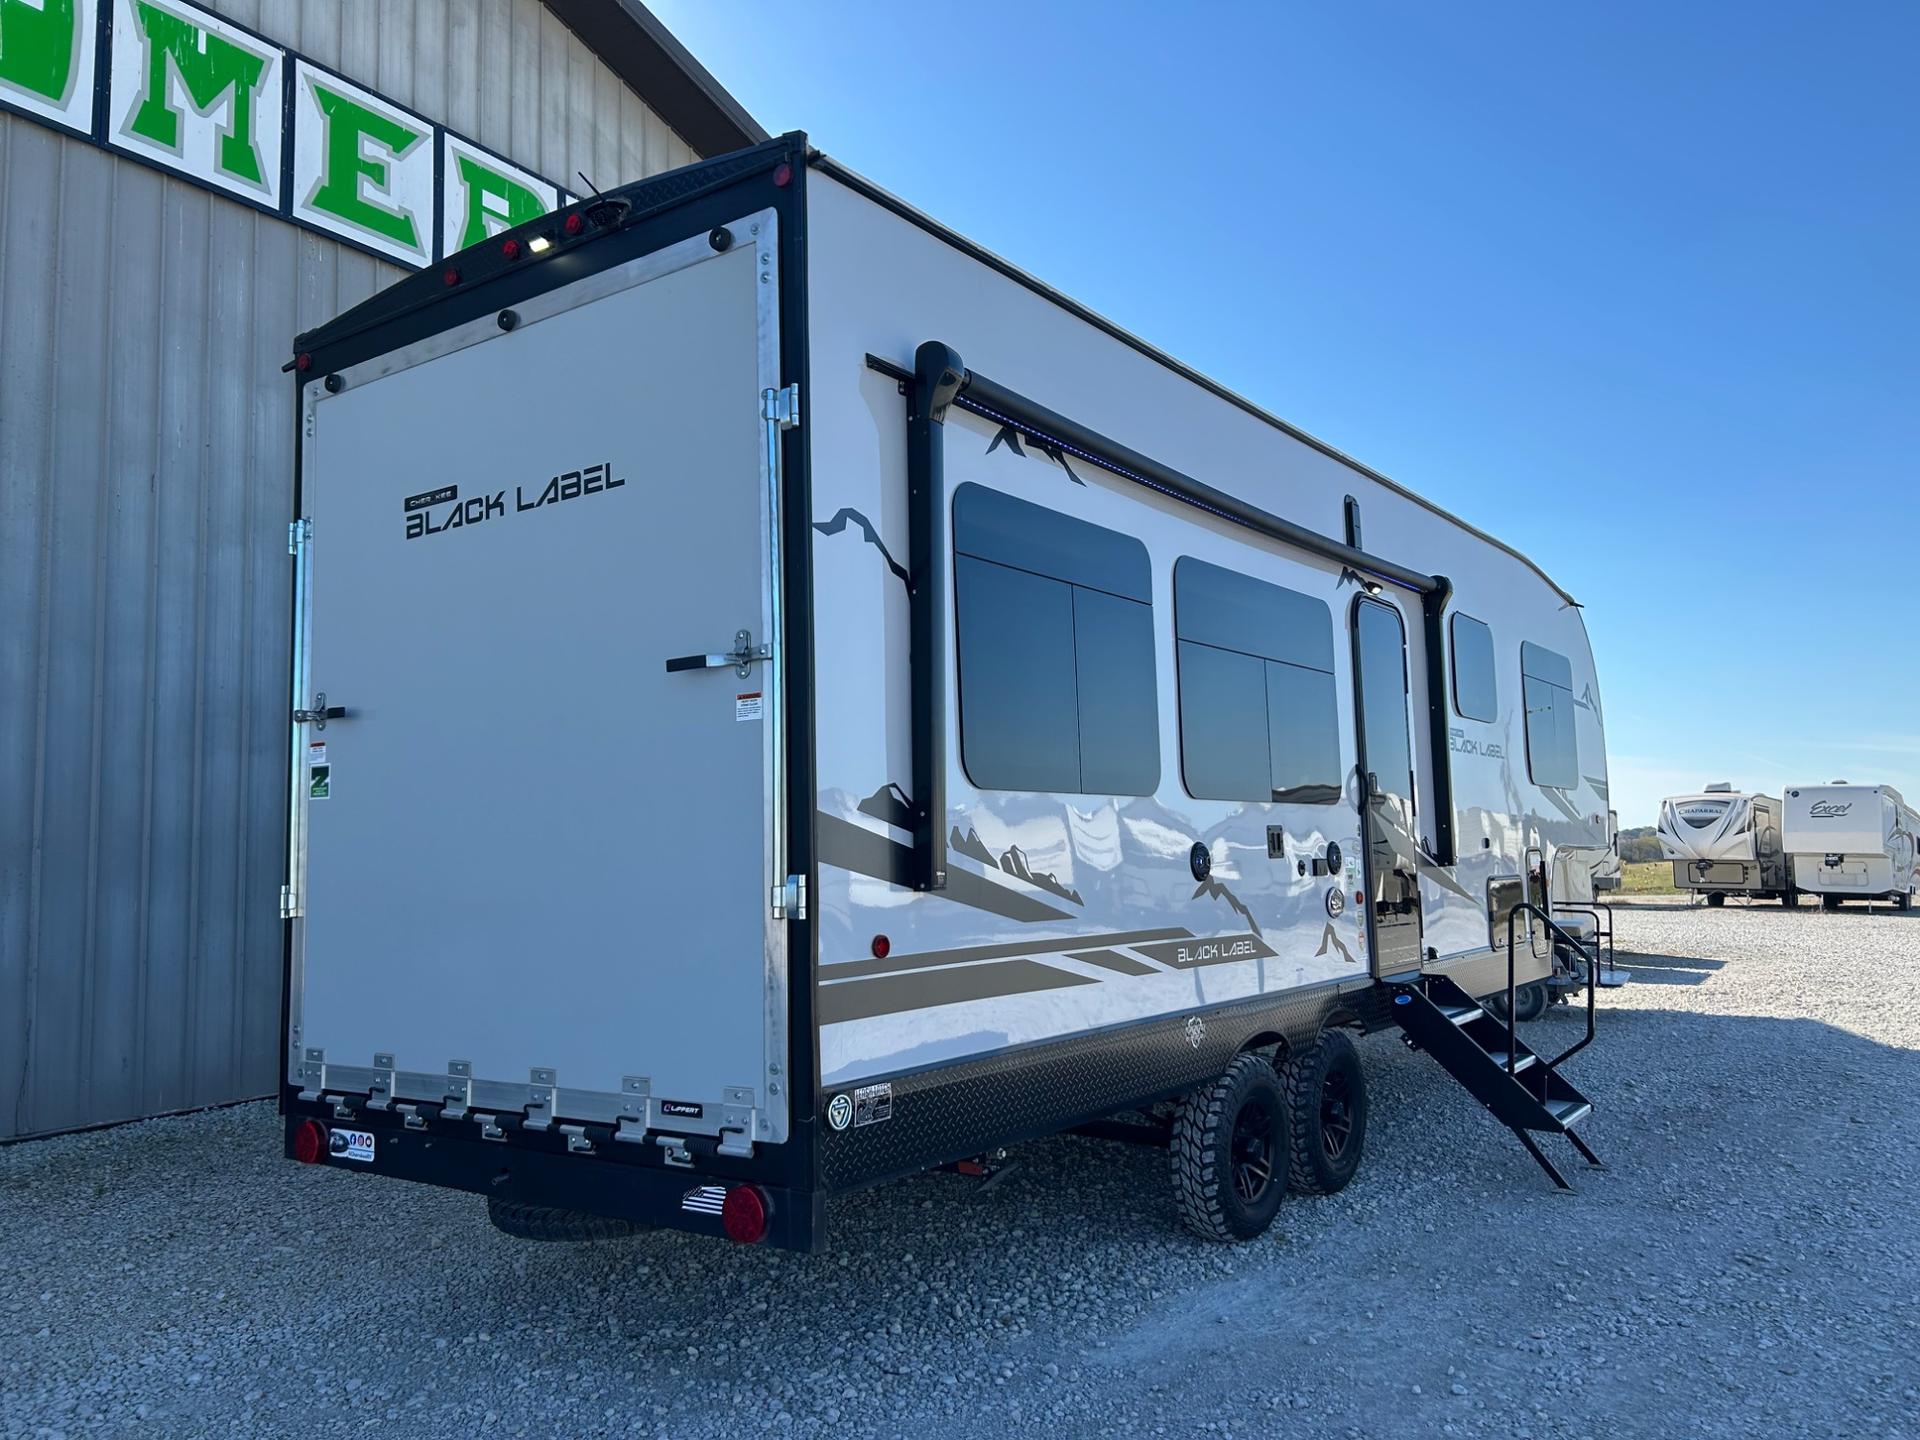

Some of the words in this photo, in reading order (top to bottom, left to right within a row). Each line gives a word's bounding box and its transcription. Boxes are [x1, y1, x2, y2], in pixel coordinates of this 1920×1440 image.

[406, 491, 506, 540] BLACK
[516, 462, 625, 512] LABEL
[409, 490, 452, 507] CHERKEE
[1450, 737, 1478, 755] BLACK
[1479, 741, 1505, 759] LABEL
[1809, 800, 1852, 816] Excel
[1178, 944, 1218, 962] BLACK
[1221, 940, 1256, 956] LABEL
